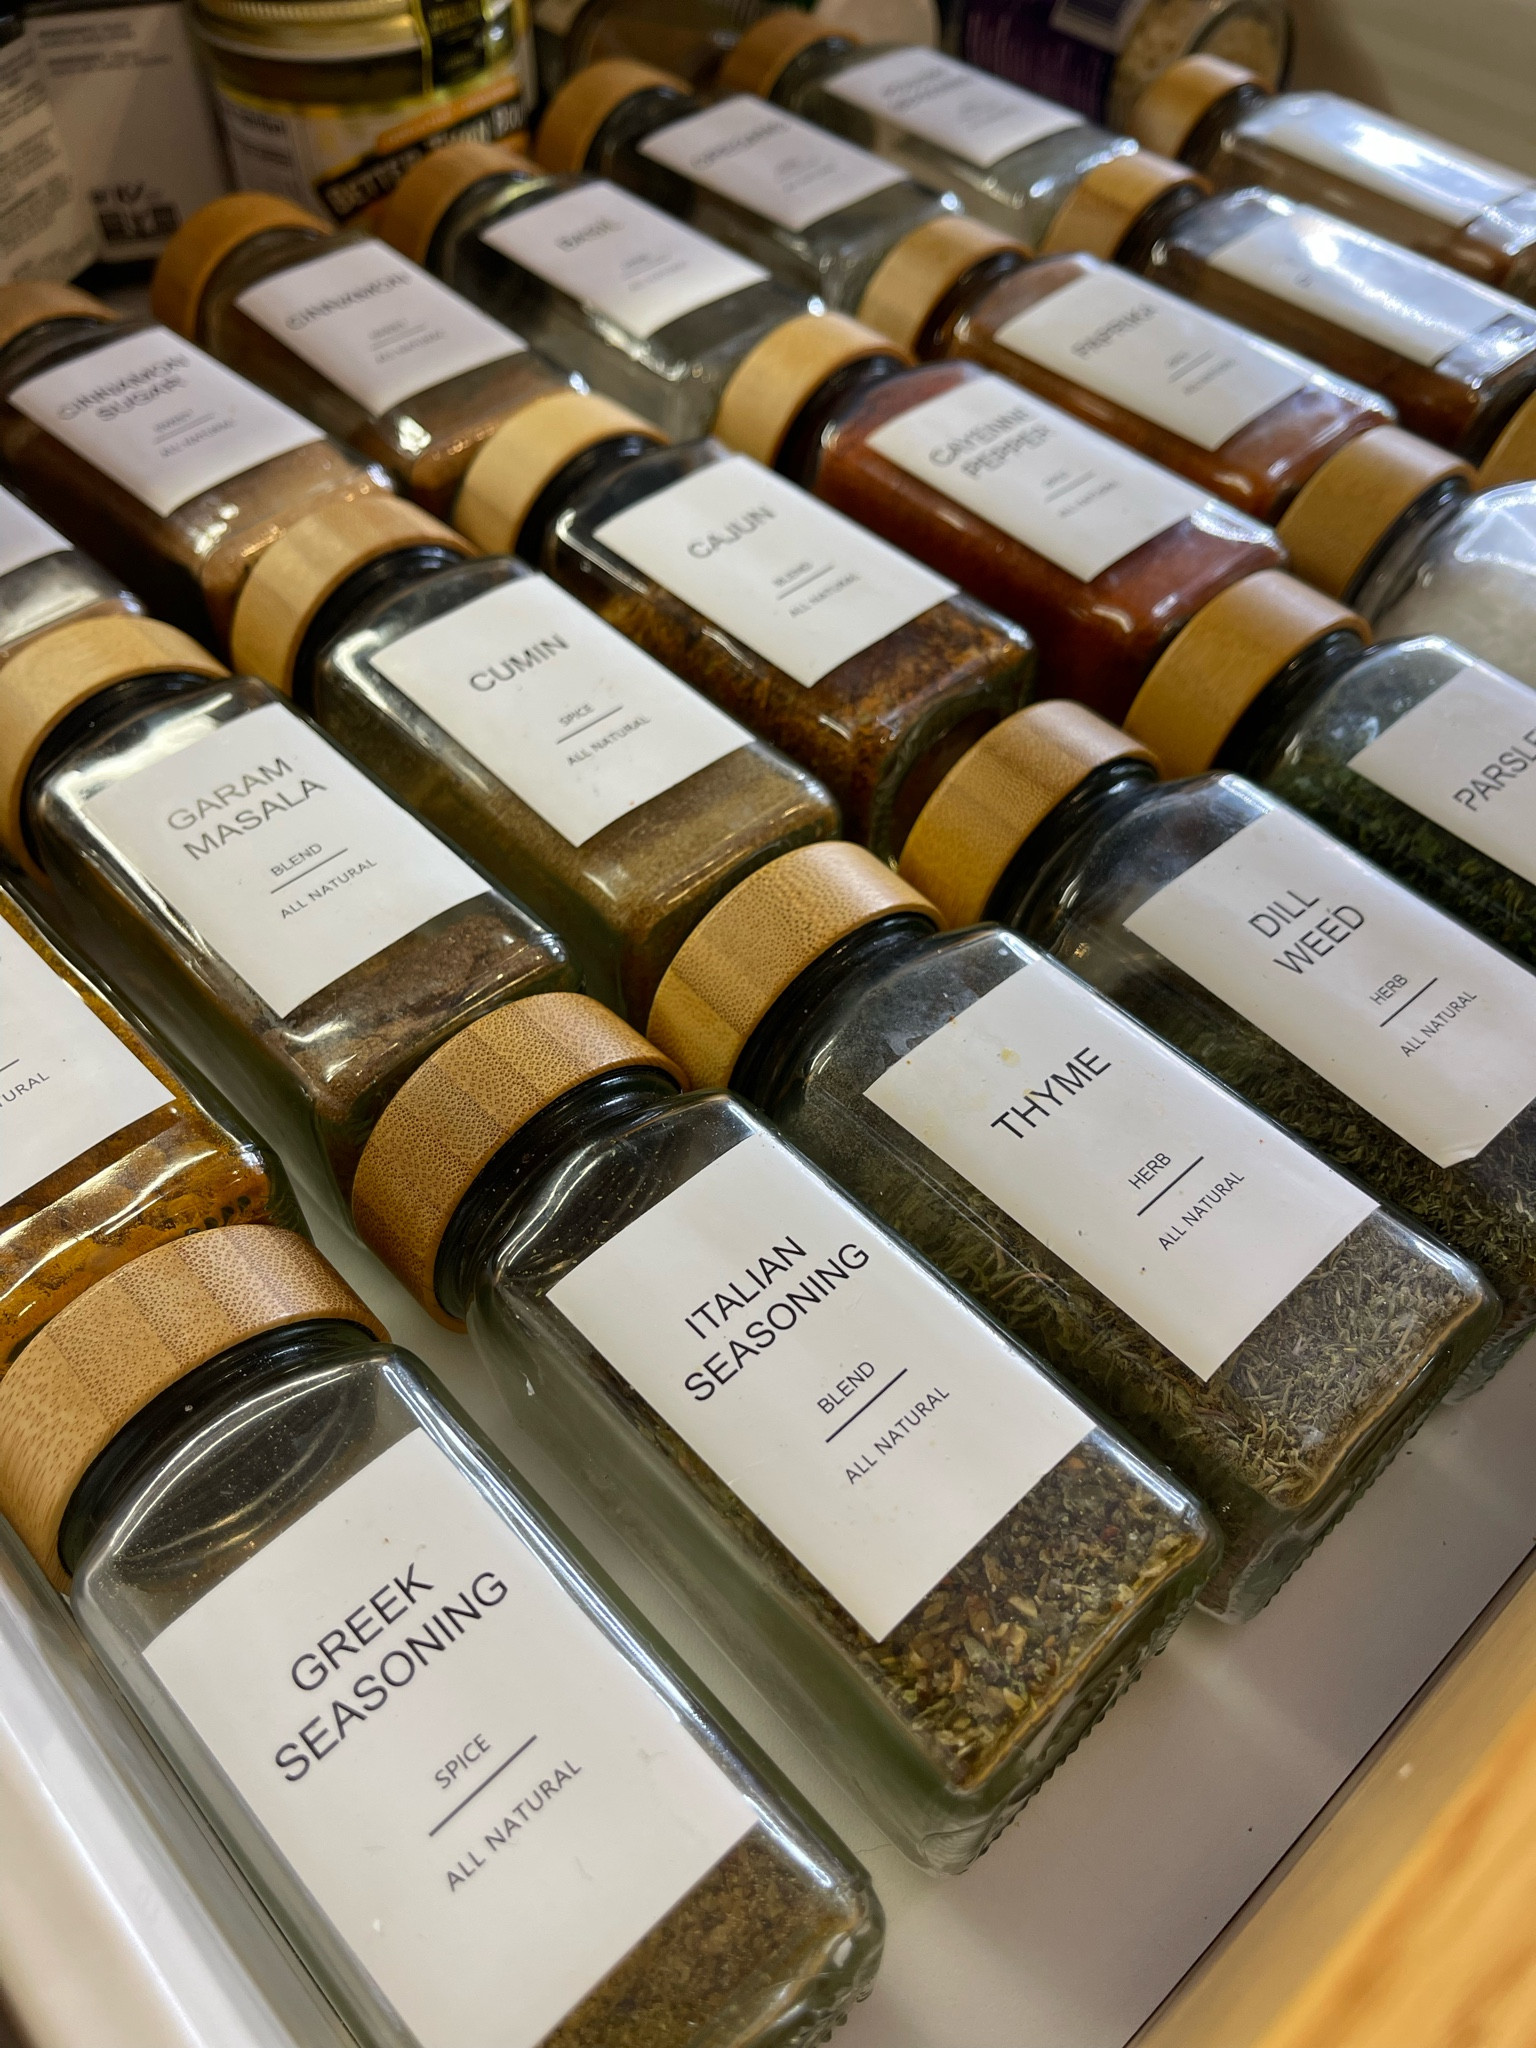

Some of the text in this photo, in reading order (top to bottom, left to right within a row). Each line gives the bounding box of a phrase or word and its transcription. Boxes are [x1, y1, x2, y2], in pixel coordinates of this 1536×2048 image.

[285, 271, 411, 331] CINNAMON
[57, 353, 191, 421] CINNAMON
[95, 374, 189, 421] SUGAR
[928, 405, 1030, 468] CAYENNE
[960, 422, 1051, 480] PEPPER
[687, 504, 777, 559] CAJUN
[470, 633, 570, 692] CUMIN
[559, 704, 596, 726] SPICE
[567, 714, 652, 766] ALL NATURAL
[168, 757, 294, 830] GARAM
[184, 778, 328, 860] MASALA
[270, 843, 322, 876] BLEND
[281, 858, 378, 919] ALL NATURAL
[1247, 889, 1320, 938] DILL
[1273, 906, 1365, 974] WEED
[1370, 974, 1408, 1006] HERB
[1400, 990, 1477, 1057] ALL NATURAL
[0, 1072, 50, 1108] URAL
[990, 1046, 1112, 1138] THYME
[1128, 1152, 1172, 1190] HERB
[1158, 1172, 1245, 1251] ALL NATURAL
[684, 1236, 807, 1340] ITALIAN
[684, 1243, 870, 1401] SEASONING
[816, 1361, 875, 1414] BLEND
[845, 1387, 950, 1485] ALL NATURAL
[291, 1562, 434, 1691] GREEK
[275, 1571, 508, 1782] SEASONING
[434, 1734, 491, 1789] SPICE
[446, 1760, 582, 1892] ALL NATURAL
